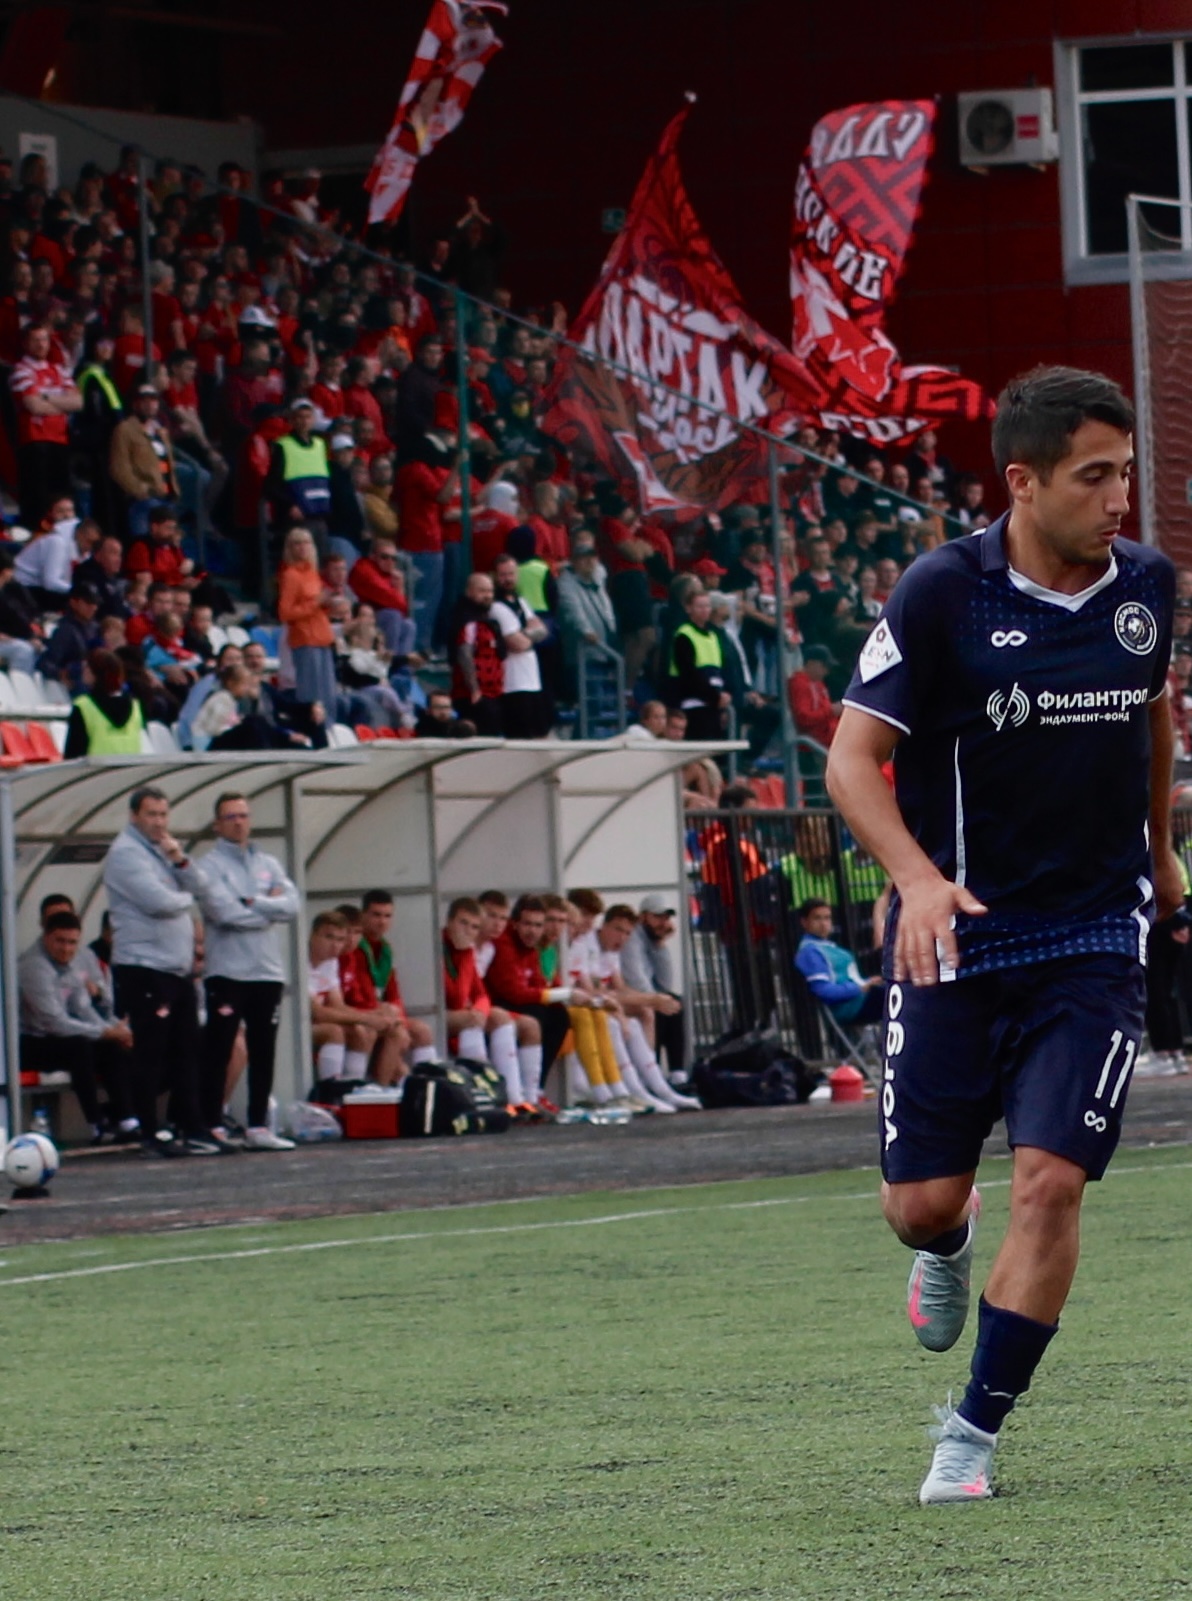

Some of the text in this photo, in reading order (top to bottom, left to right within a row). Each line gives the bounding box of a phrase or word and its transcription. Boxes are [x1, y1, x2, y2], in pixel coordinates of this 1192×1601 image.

[1036, 688, 1149, 711] Филантроп
[1039, 711, 1130, 726] ЭНДАУМЕНТ-ФОНД
[1094, 1029, 1136, 1109] 11
